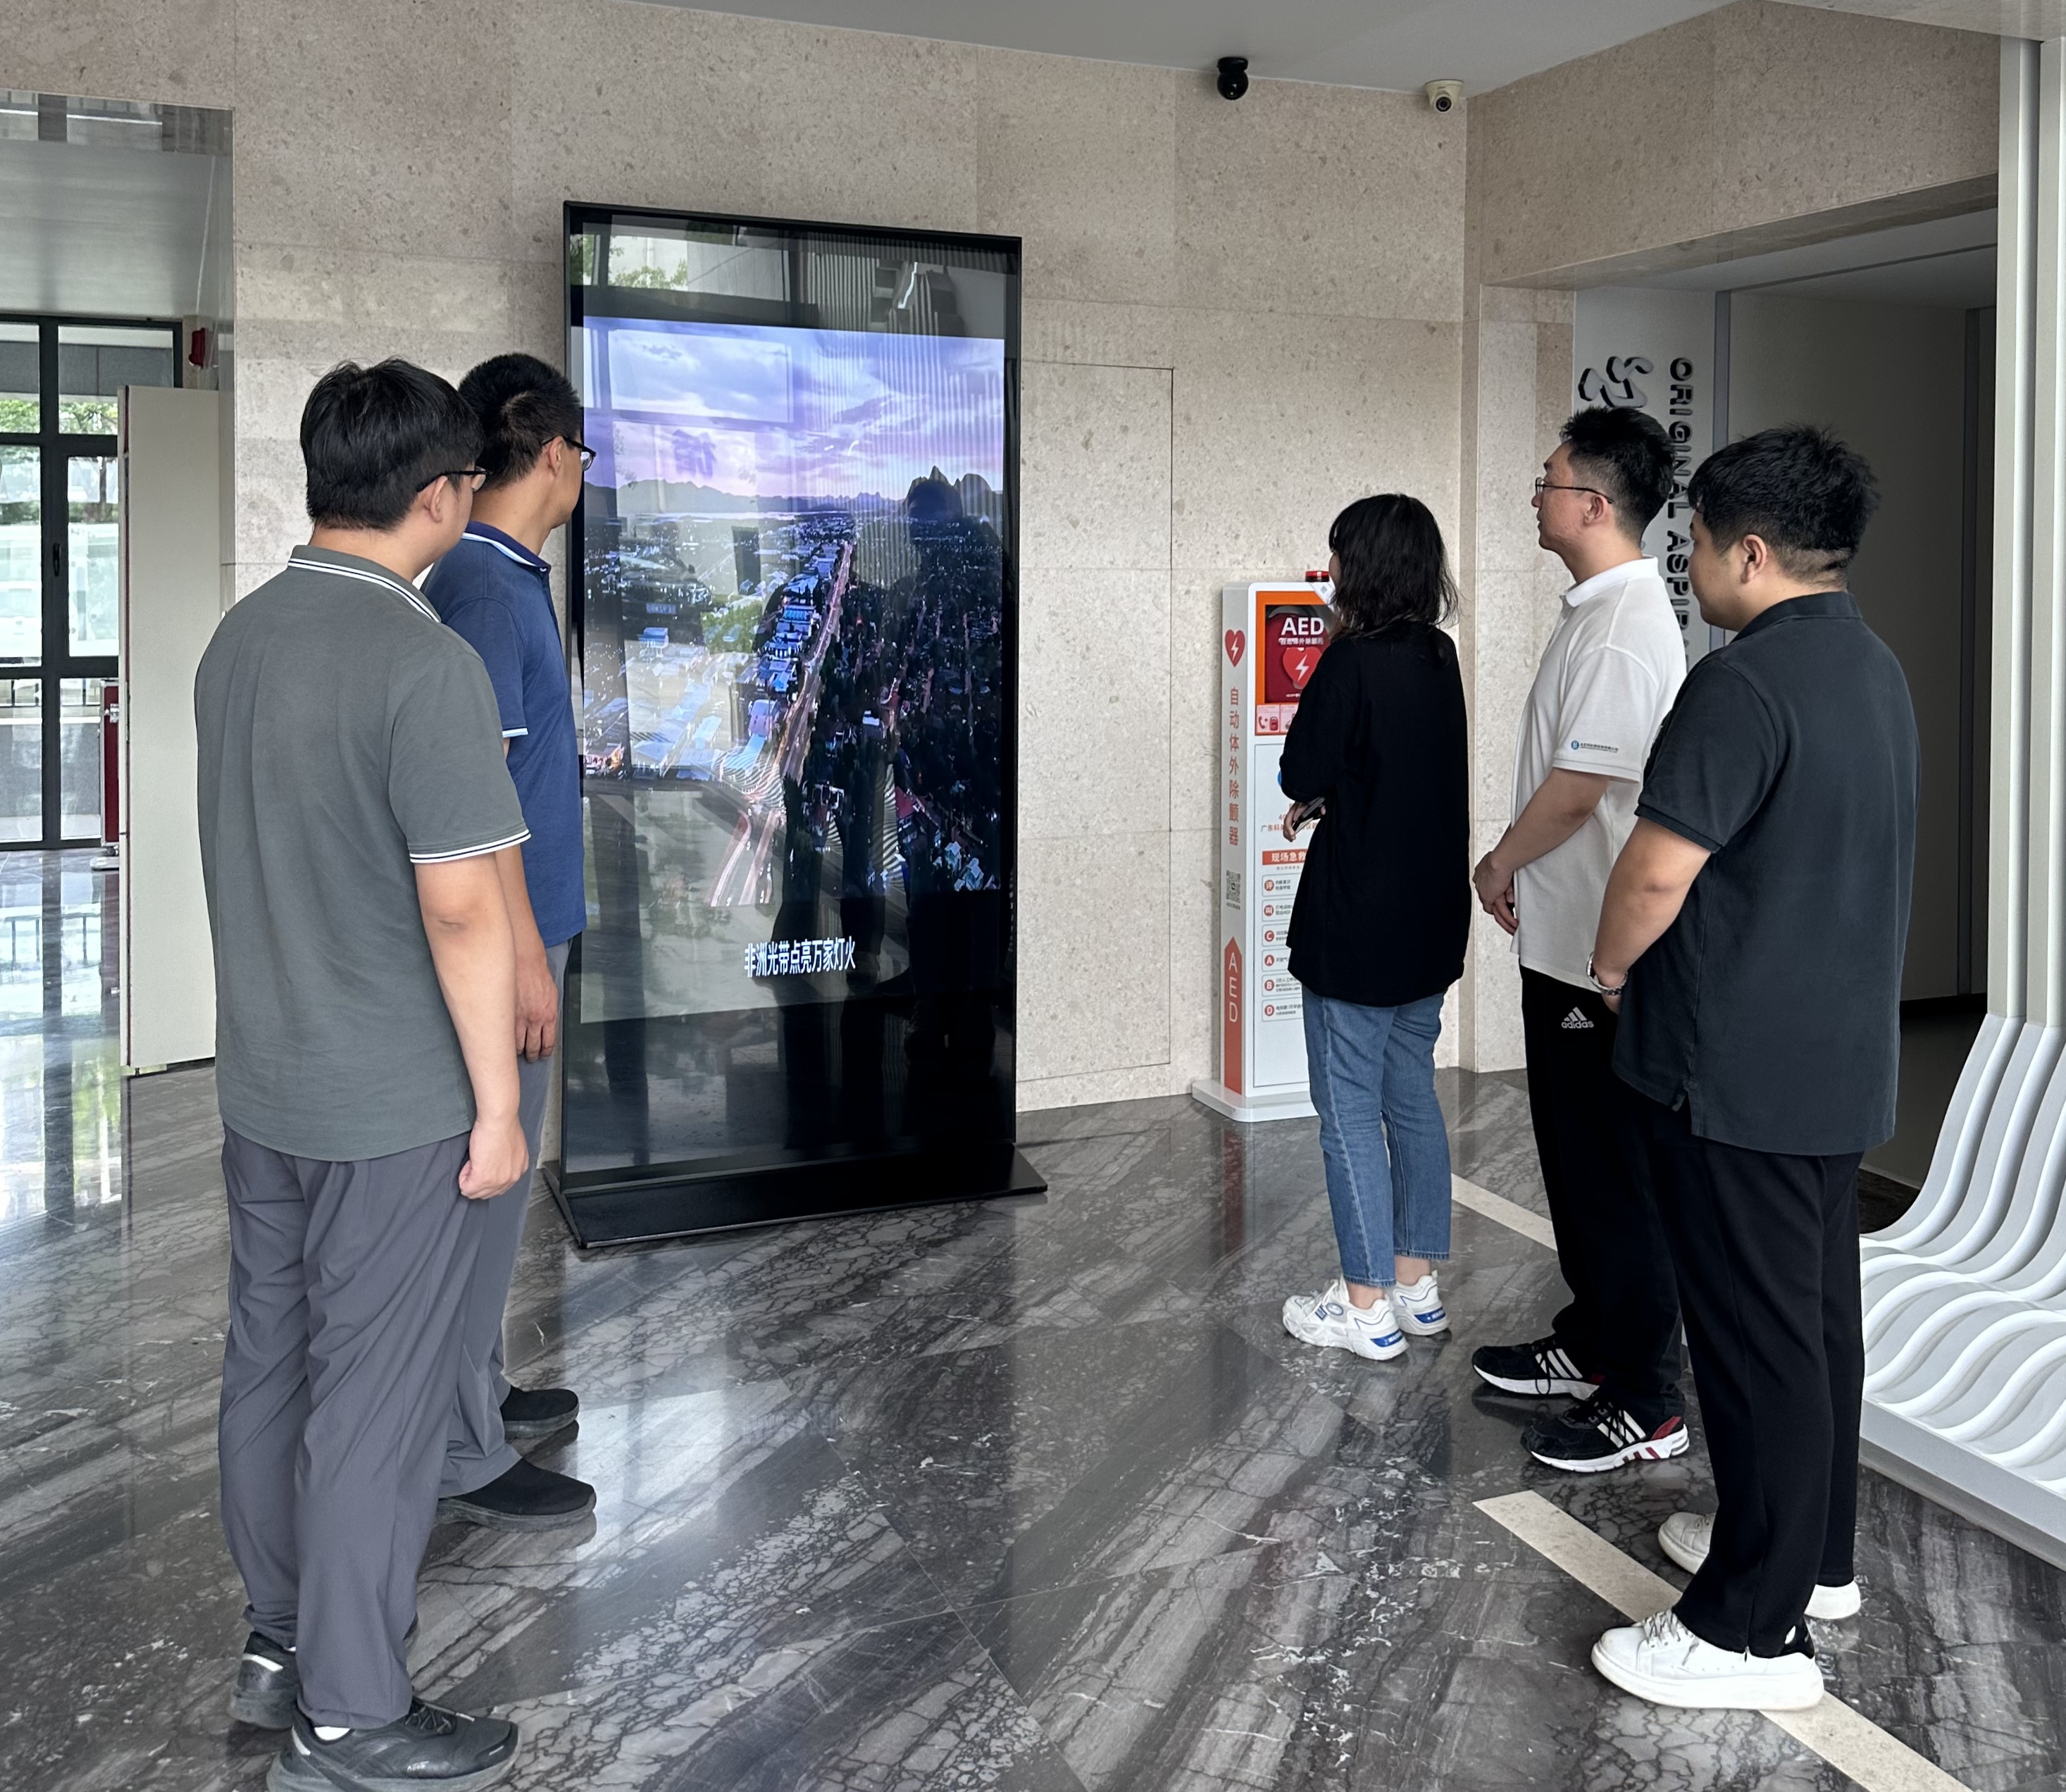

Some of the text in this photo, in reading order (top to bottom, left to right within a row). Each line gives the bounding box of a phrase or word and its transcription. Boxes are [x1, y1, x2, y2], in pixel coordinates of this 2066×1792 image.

[1667, 358, 1693, 519] ORIGINAL
[1281, 617, 1324, 635] AED
[1228, 686, 1239, 846] 自动体外除颤器
[1266, 931, 1272, 940] C
[745, 935, 856, 978] 非洲光带点亮万家灯火
[1266, 956, 1273, 965] A
[1228, 952, 1238, 1022] AED
[1266, 981, 1272, 990] B
[1266, 1007, 1273, 1015] D
